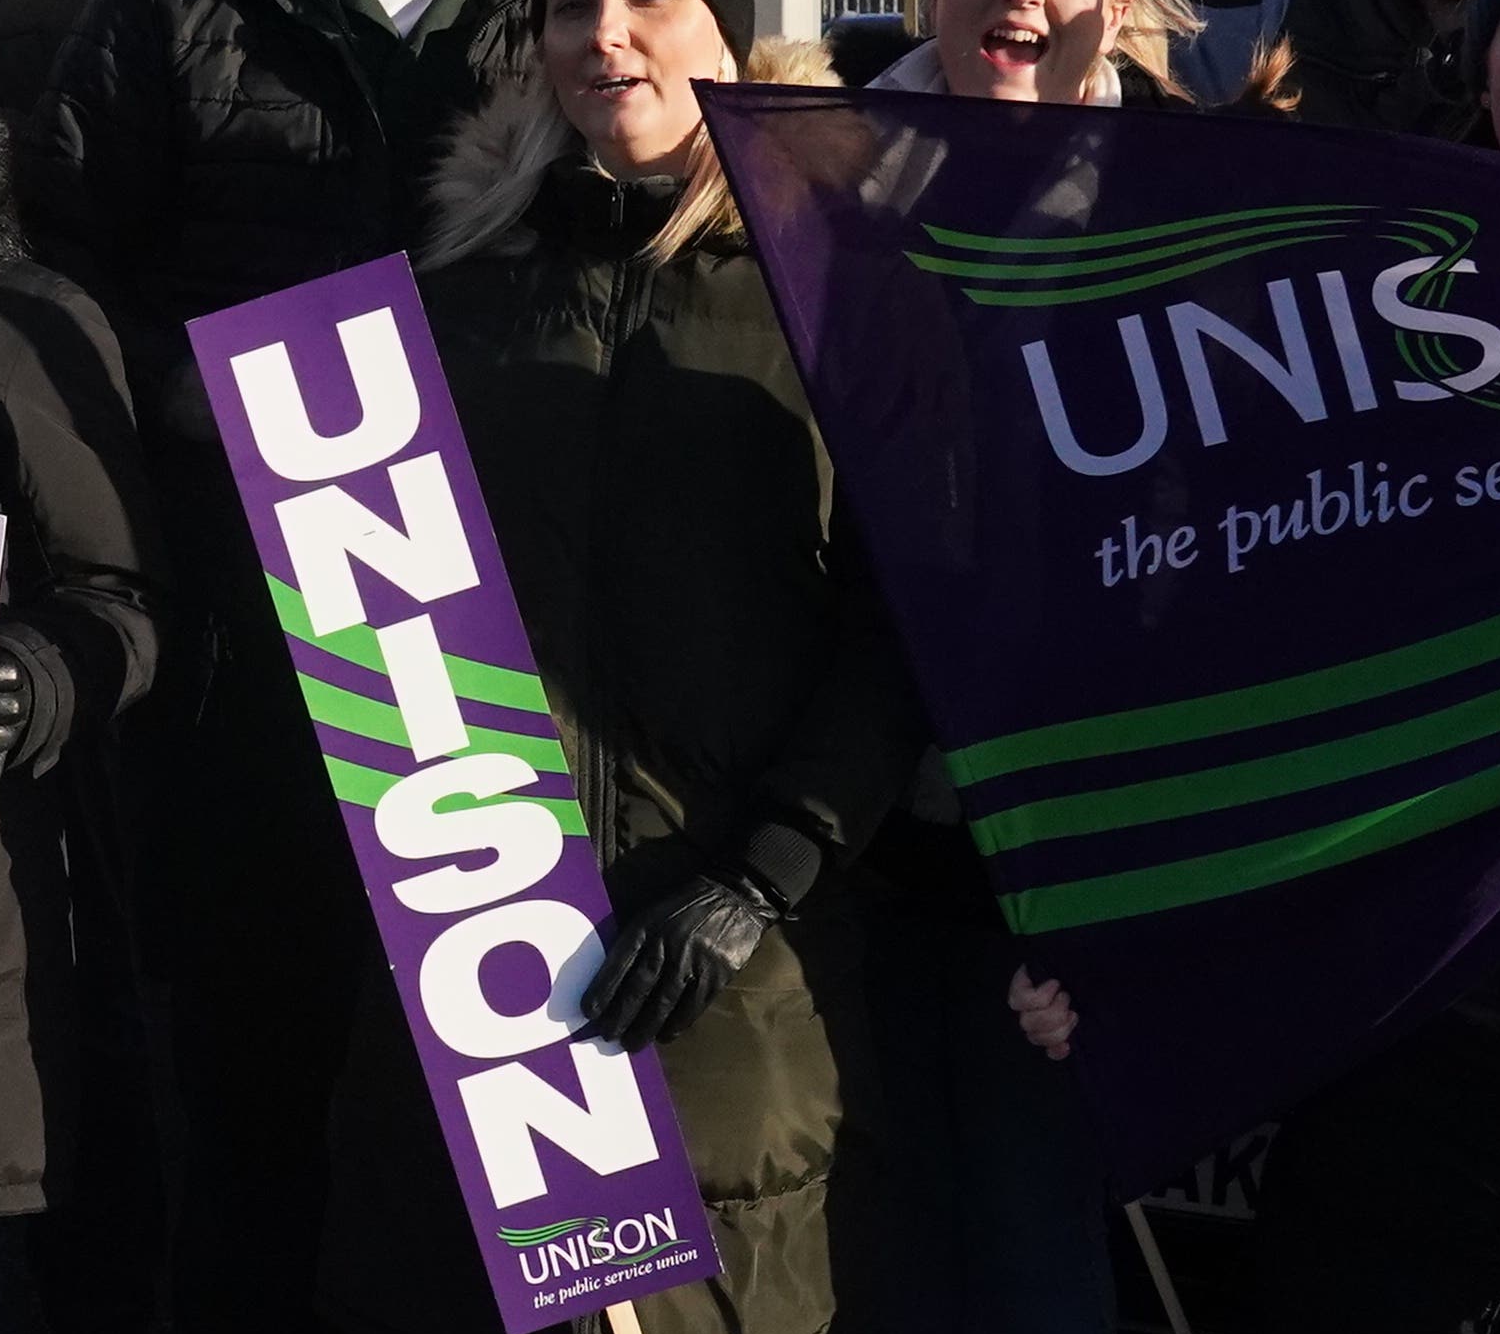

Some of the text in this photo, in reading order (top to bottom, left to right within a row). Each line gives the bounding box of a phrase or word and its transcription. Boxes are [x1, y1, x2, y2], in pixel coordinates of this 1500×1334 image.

[1095, 513, 1199, 588] the
[1218, 460, 1434, 574] public
[229, 305, 660, 1211] UNISON
[519, 1207, 678, 1285] UNISON
[533, 1248, 698, 1309] the public service union
